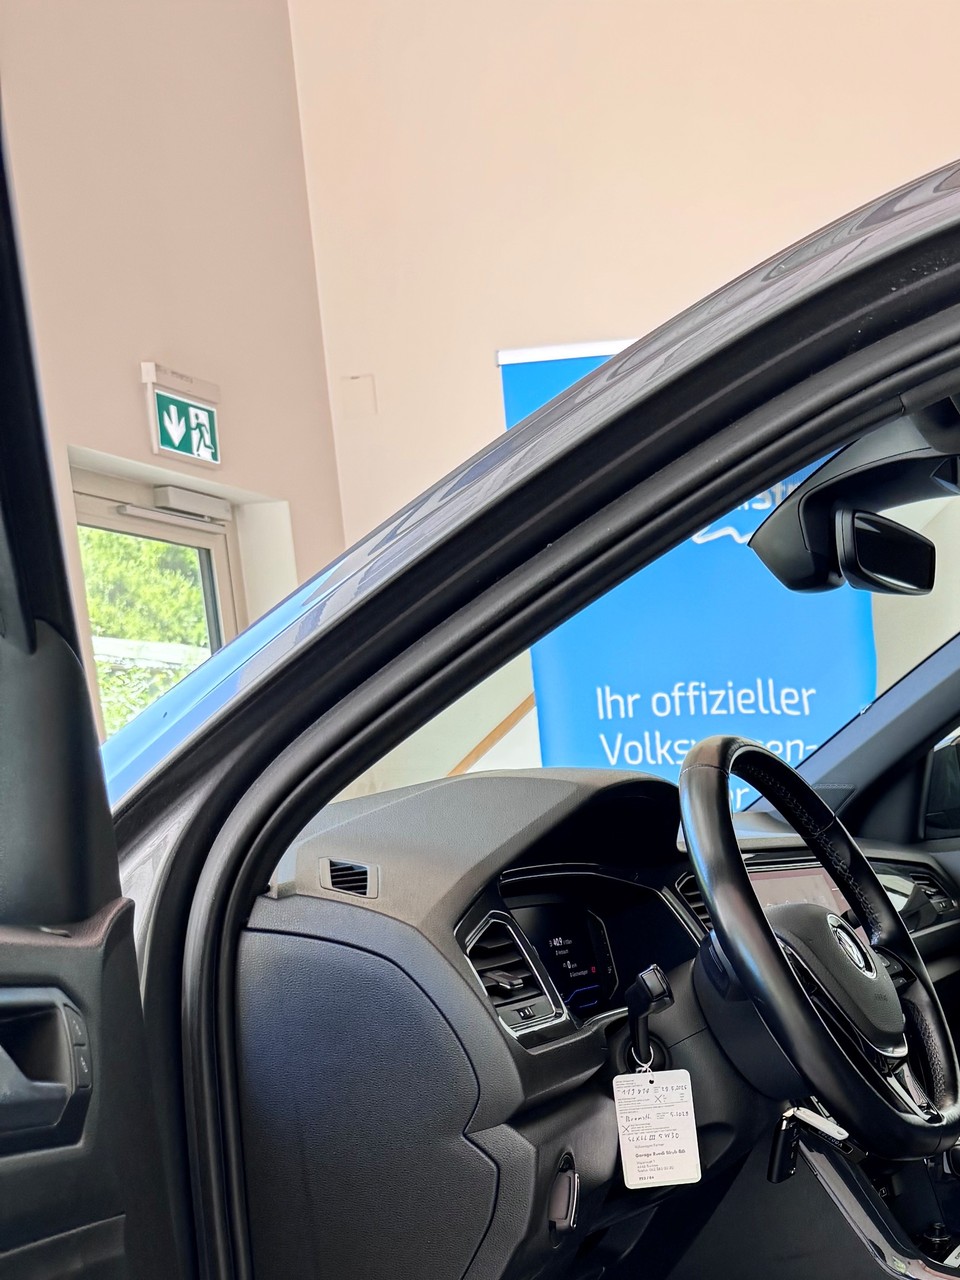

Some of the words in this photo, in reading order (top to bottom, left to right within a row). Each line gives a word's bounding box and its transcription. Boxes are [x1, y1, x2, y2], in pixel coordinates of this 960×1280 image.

[596, 685, 640, 720] Ihr
[652, 678, 816, 718] offizieller
[599, 730, 818, 766] Volksen-
